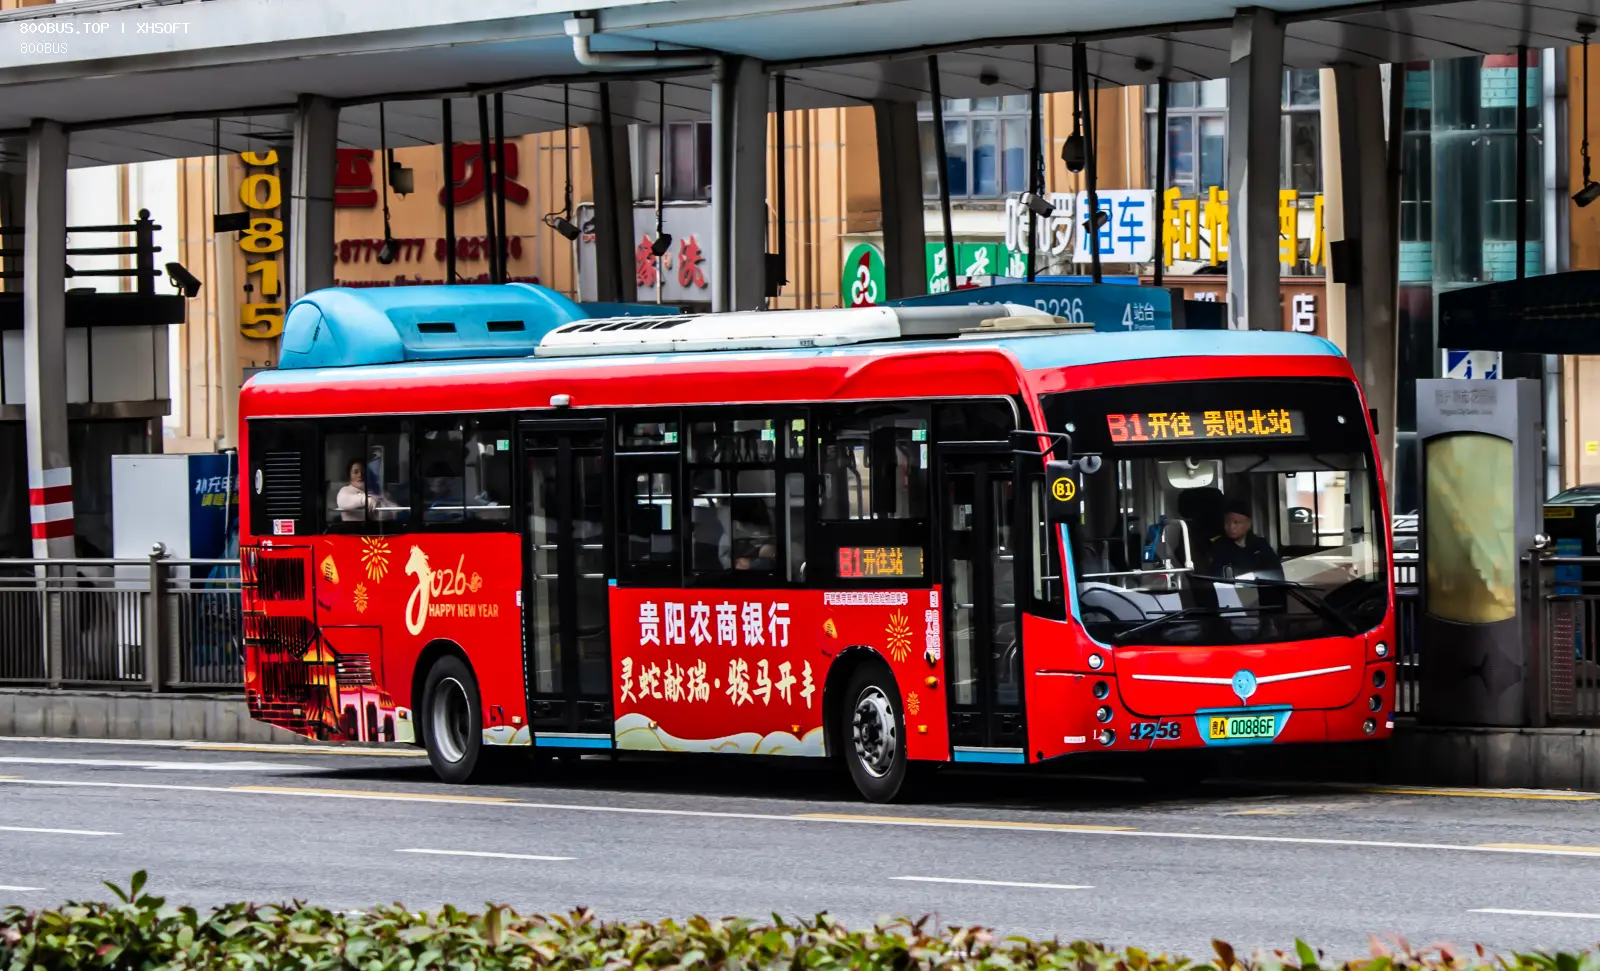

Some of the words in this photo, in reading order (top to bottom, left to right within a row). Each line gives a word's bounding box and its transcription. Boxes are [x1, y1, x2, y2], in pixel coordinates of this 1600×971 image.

[239, 151, 285, 339] 0815
[1106, 414, 1148, 442] B1
[1148, 412, 1194, 438] 开往
[1203, 408, 1292, 436] 贵阳北站
[1056, 483, 1072, 496] B1
[839, 547, 863, 577] B1
[429, 603, 455, 618] HAPPY
[457, 603, 477, 618] NEW
[478, 603, 499, 618] YEAR
[638, 601, 791, 648] 贵阳农商银行
[1130, 722, 1181, 740] 4258
